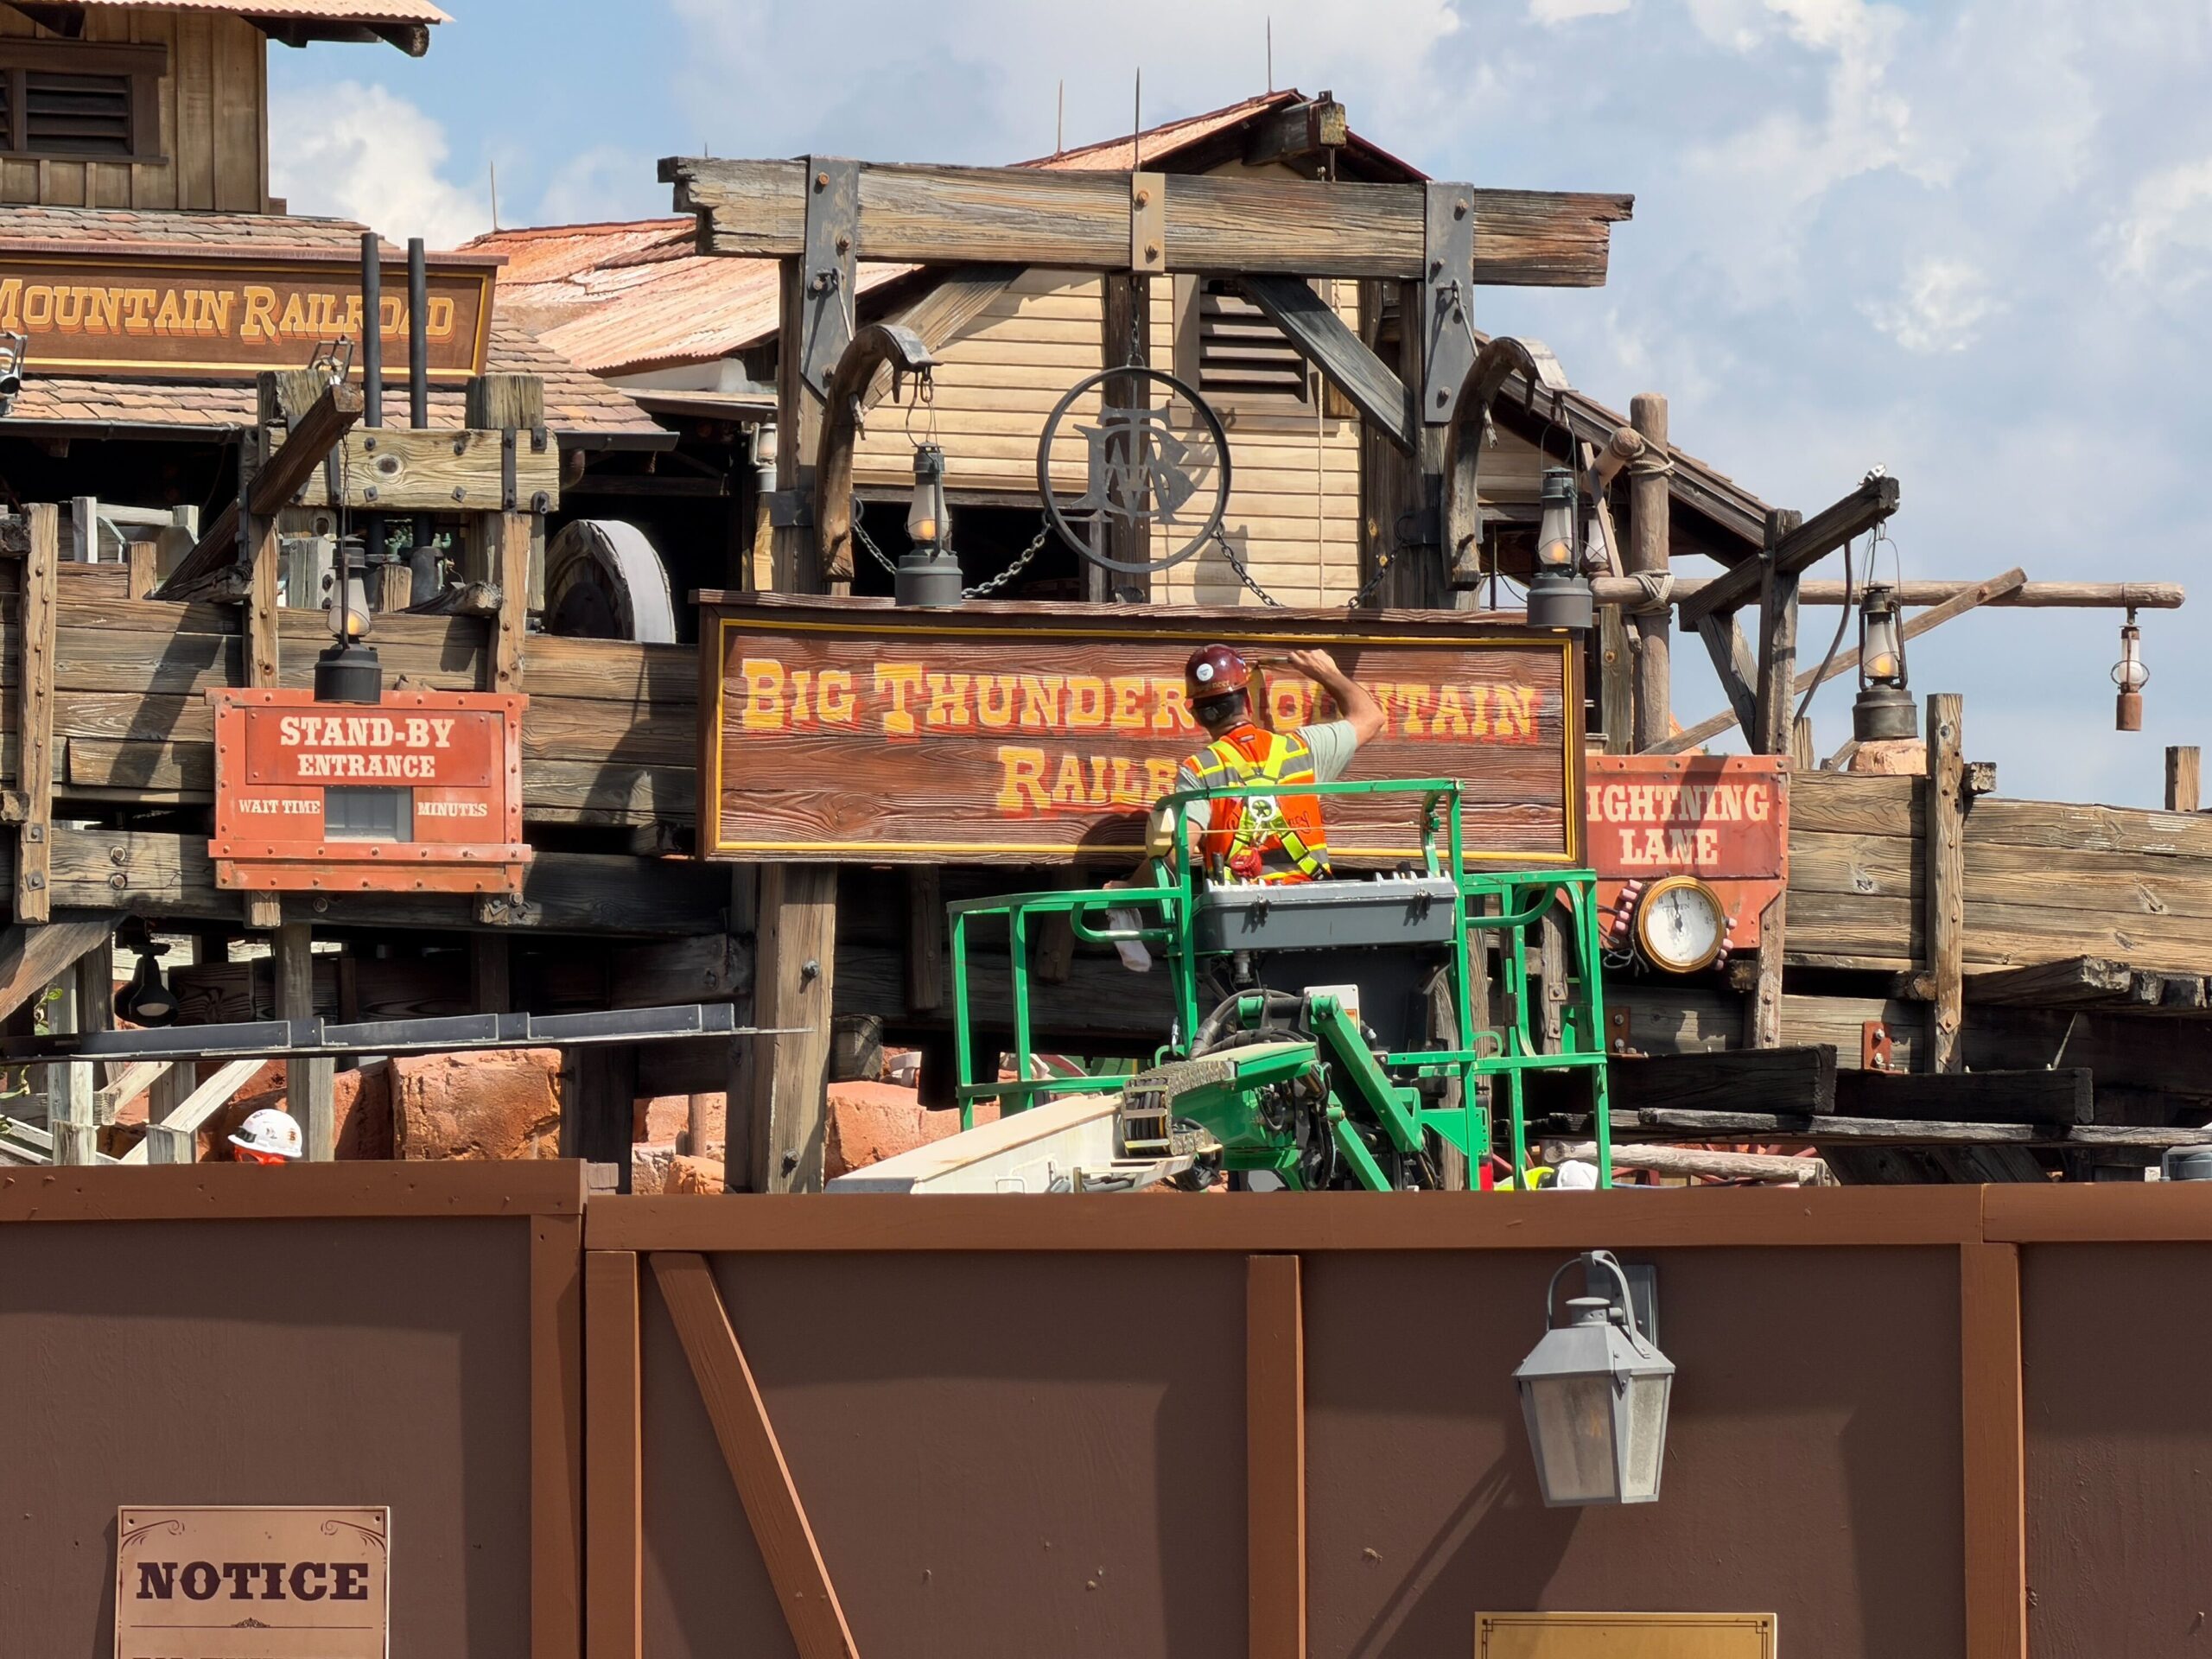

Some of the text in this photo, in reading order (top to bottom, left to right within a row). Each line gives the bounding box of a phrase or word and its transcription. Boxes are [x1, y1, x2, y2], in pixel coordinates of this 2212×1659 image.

[741, 658, 1536, 736] BIG THUNDER OTAIN
[280, 716, 455, 748] STAND-BY
[297, 753, 435, 778] ENTRANCE
[996, 745, 1179, 811] RAILR
[238, 798, 321, 815] WAIT TIME
[417, 801, 488, 817] MINUTES
[1586, 784, 1770, 823] IGHTNING
[1619, 828, 1718, 865] LANE
[137, 1560, 369, 1601] NOTICE
